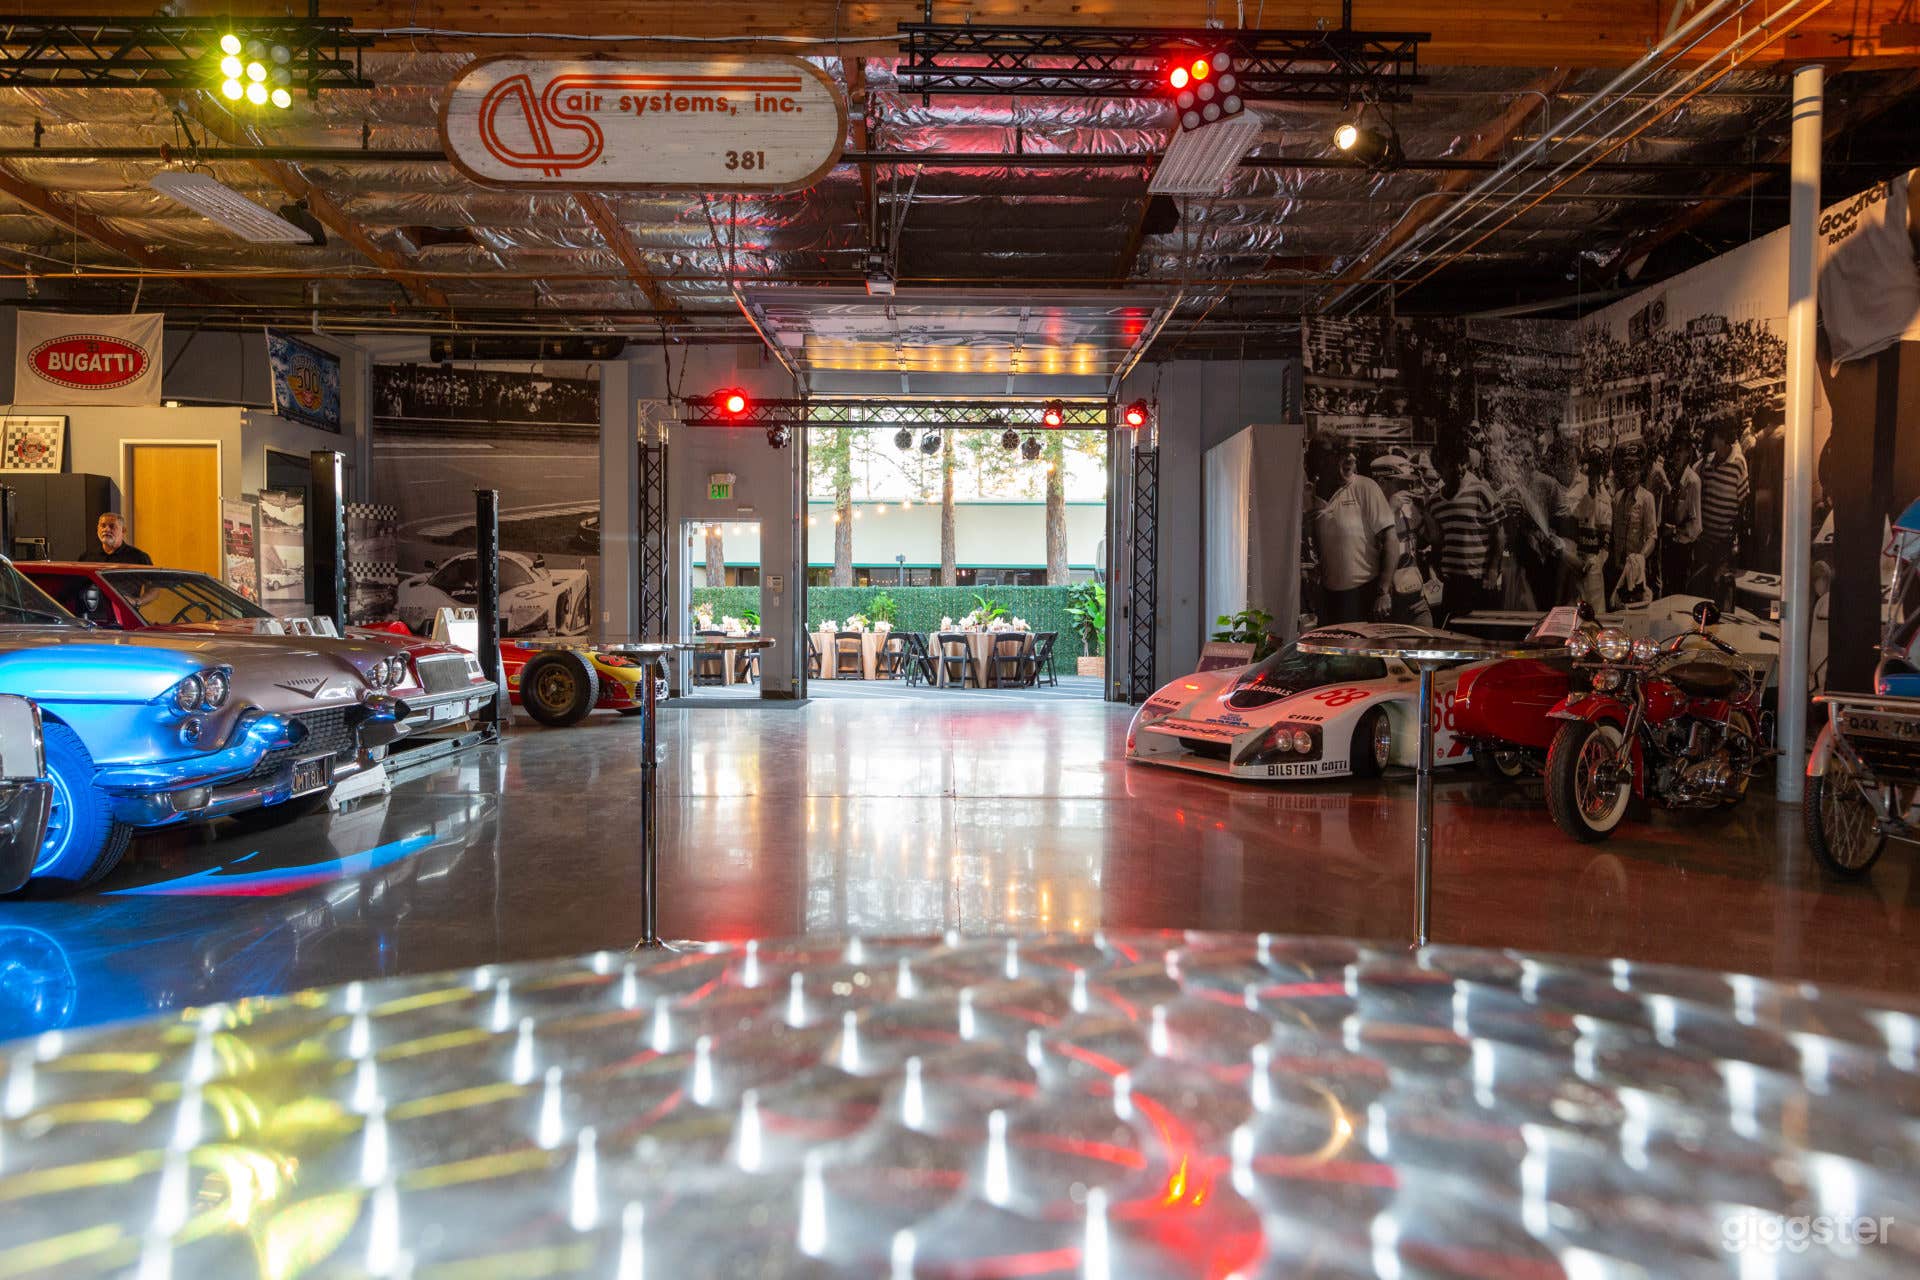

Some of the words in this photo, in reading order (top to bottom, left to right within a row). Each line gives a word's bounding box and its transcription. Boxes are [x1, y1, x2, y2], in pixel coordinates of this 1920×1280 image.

[566, 92, 602, 112] air
[618, 92, 737, 116] systems,
[755, 92, 803, 112] inc.
[724, 151, 766, 170] 381
[47, 351, 134, 372] BUGATTI
[712, 484, 729, 498] EXIT
[1251, 685, 1292, 696] RADIALS
[1313, 688, 1370, 707] 68
[1268, 765, 1318, 776] BILSTEIN
